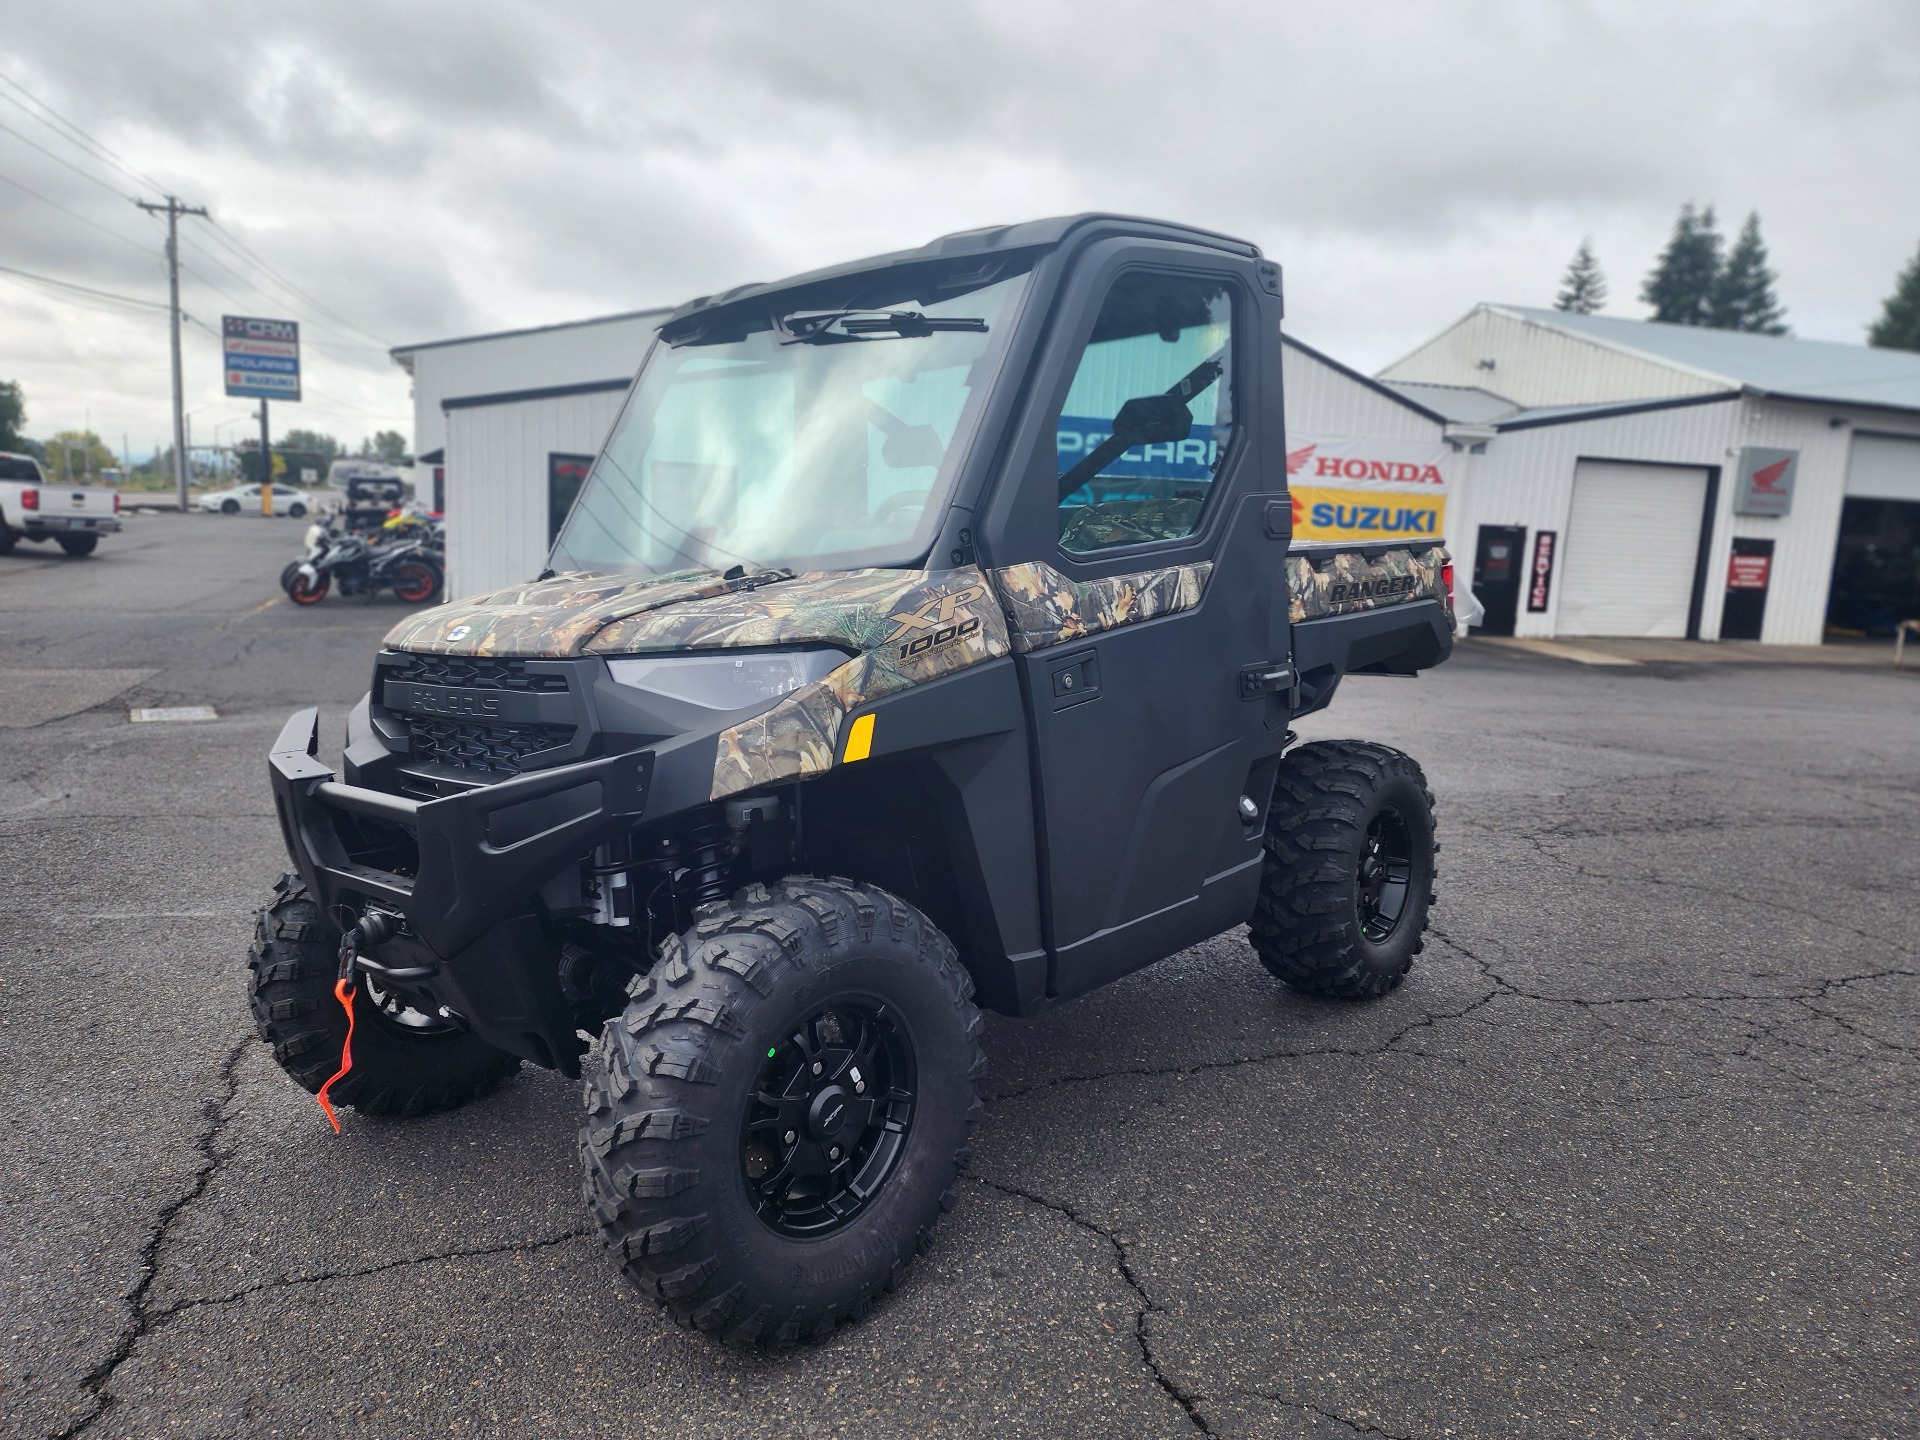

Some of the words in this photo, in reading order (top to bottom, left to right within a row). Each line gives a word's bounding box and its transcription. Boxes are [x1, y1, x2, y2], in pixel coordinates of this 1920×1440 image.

[1314, 456, 1444, 485] HONDA
[1103, 512, 1164, 524] POLARIS
[1311, 502, 1437, 533] SUZUKI
[1531, 534, 1553, 608] SERVICE
[1329, 575, 1416, 605] RANGER
[877, 585, 986, 648] XP
[899, 616, 980, 660] 1000
[412, 690, 499, 717] POLARIS
